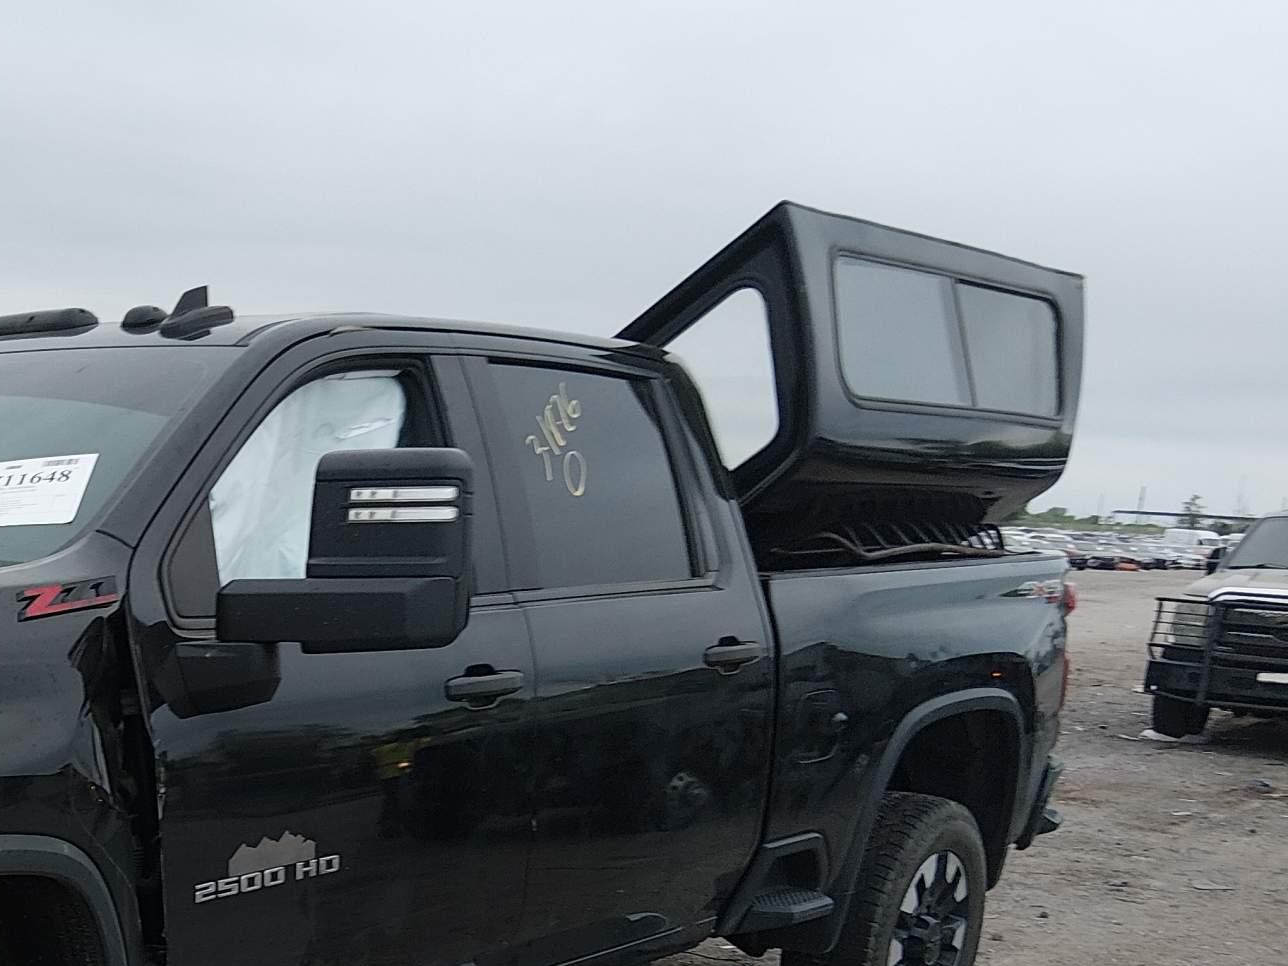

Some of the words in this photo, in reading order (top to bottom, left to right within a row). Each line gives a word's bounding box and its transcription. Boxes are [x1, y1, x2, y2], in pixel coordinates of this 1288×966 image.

[16, 575, 120, 622] Z71
[193, 866, 287, 904] 2500
[294, 853, 342, 881] HD
